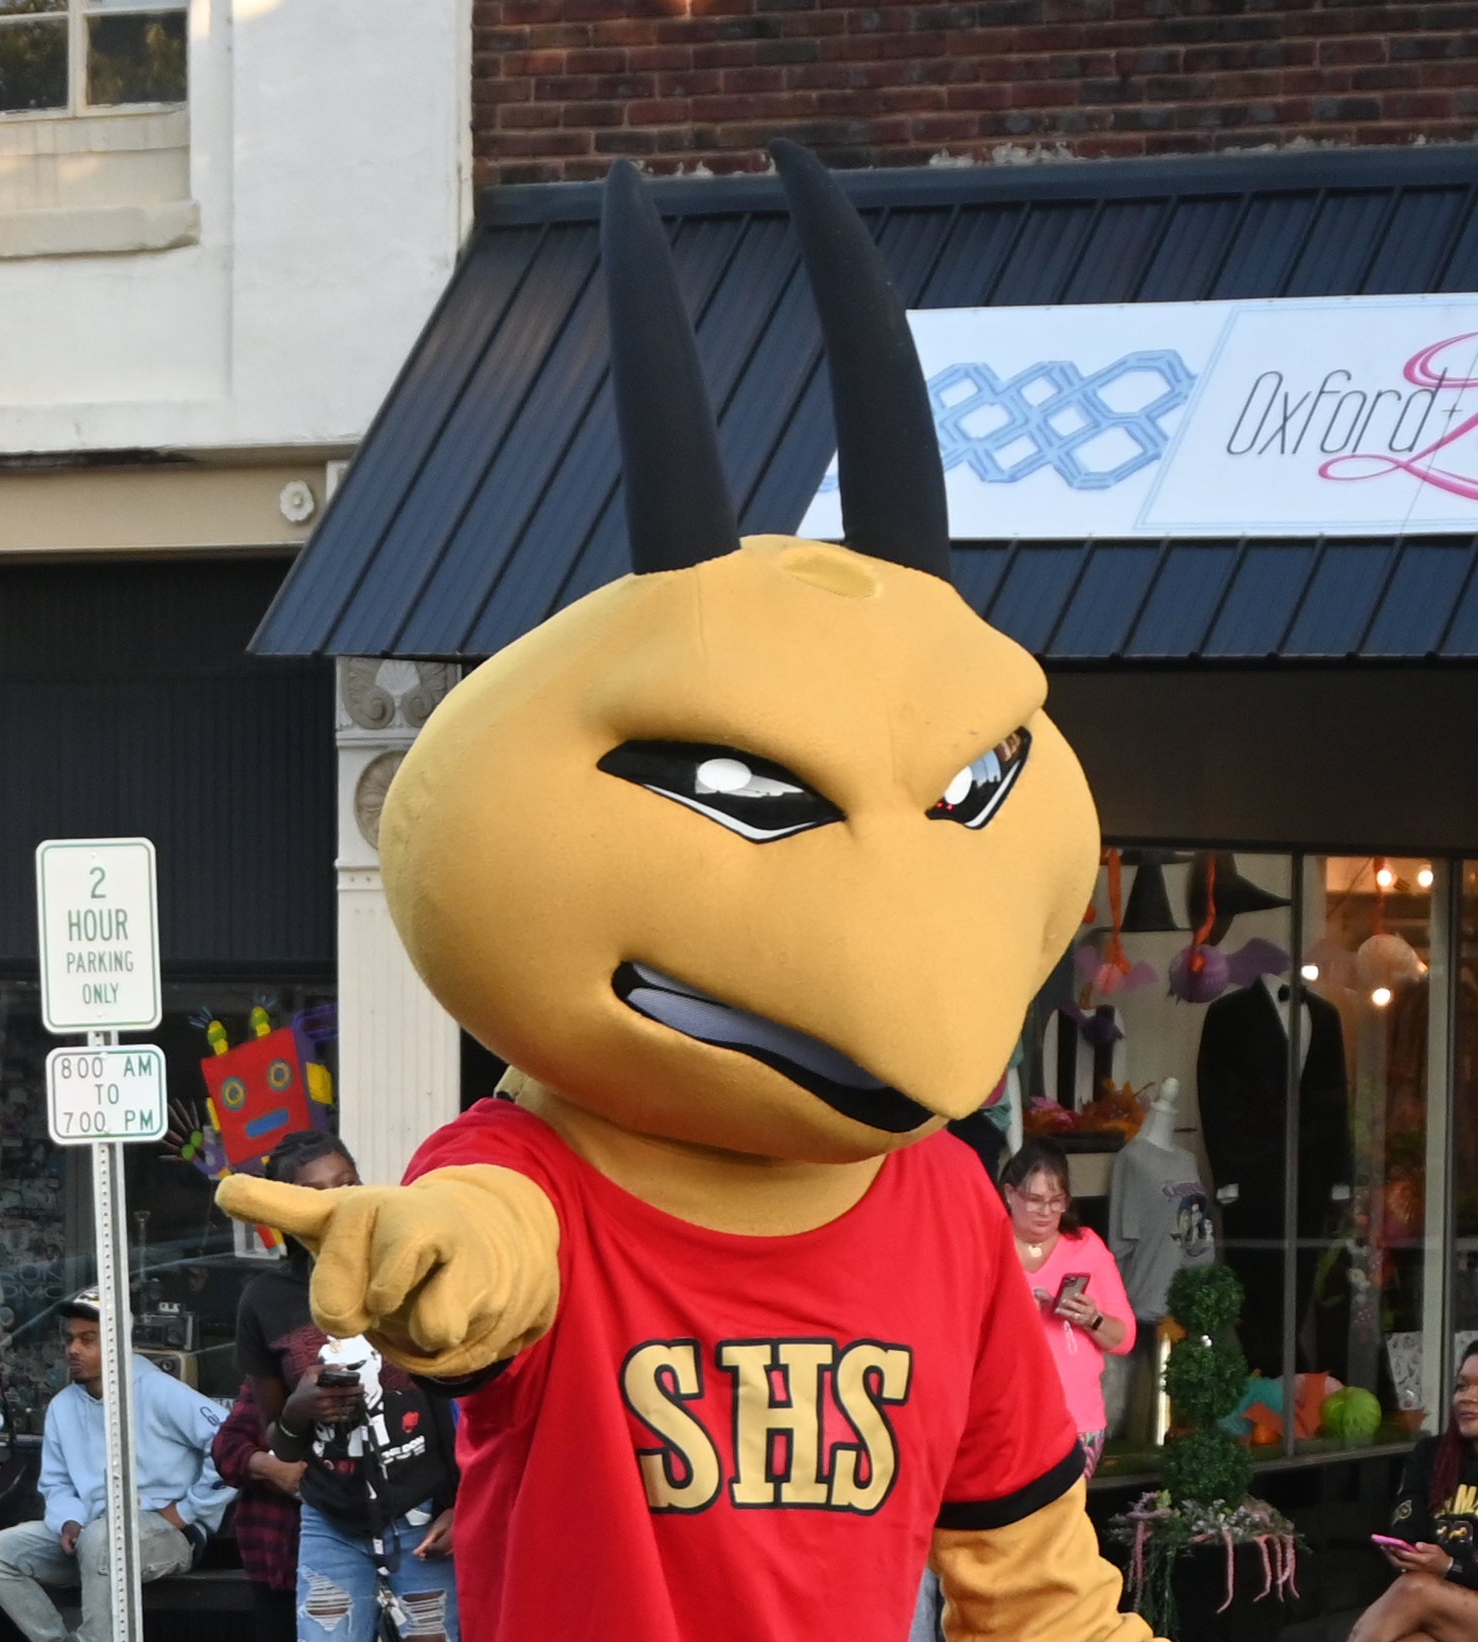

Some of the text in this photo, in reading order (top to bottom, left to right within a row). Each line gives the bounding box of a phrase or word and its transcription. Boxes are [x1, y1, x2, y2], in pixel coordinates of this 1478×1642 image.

[1226, 367, 1448, 456] Oxford
[89, 866, 106, 899] 2
[68, 908, 128, 942] HOUR
[66, 951, 134, 974] PARKING
[82, 983, 119, 1005] ONLY
[123, 1055, 153, 1078] AM
[94, 1083, 120, 1106] TO
[124, 1109, 154, 1132] PM
[619, 1336, 913, 1517] SHS
